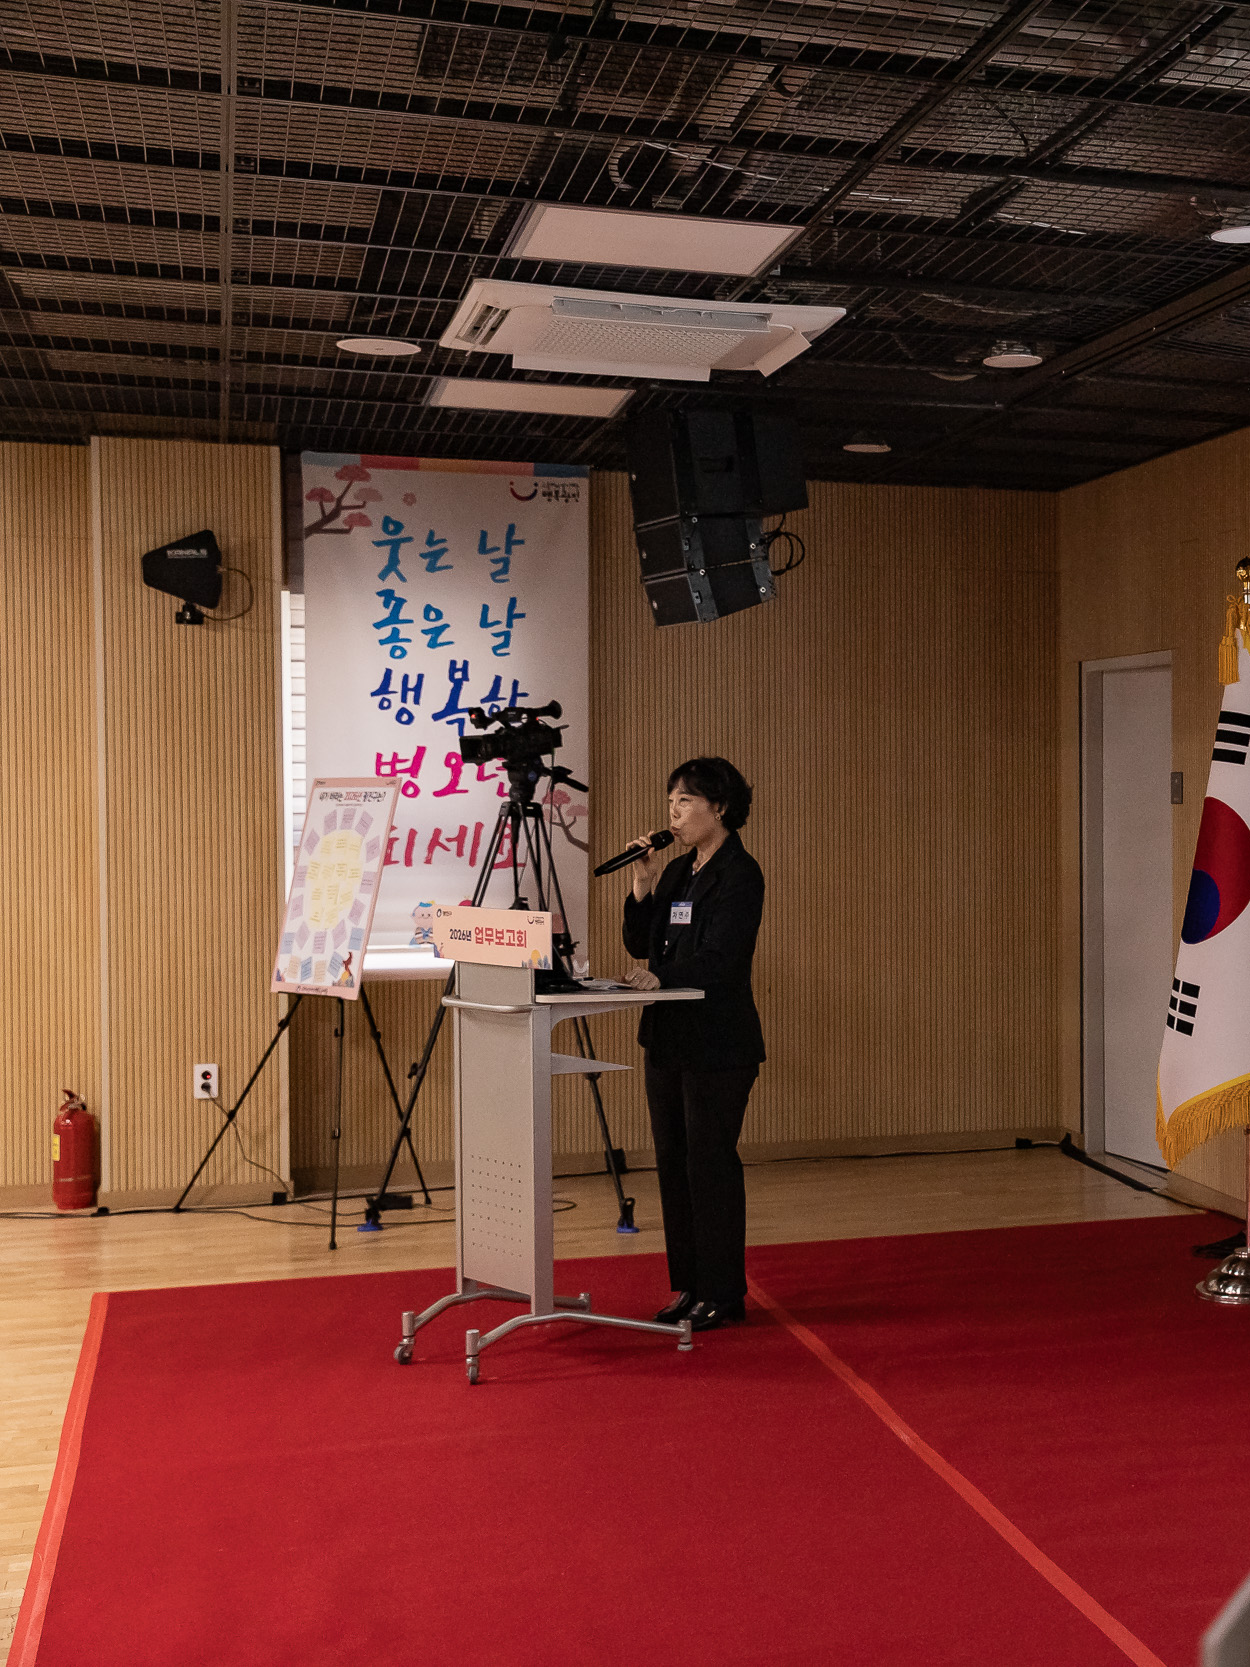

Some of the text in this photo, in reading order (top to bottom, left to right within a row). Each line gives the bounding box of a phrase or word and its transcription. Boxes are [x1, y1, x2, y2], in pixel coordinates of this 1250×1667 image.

[371, 514, 525, 584] 웃는 날
[372, 588, 527, 660] 좋은 날
[449, 926, 527, 948] 2026년 업무보고회
